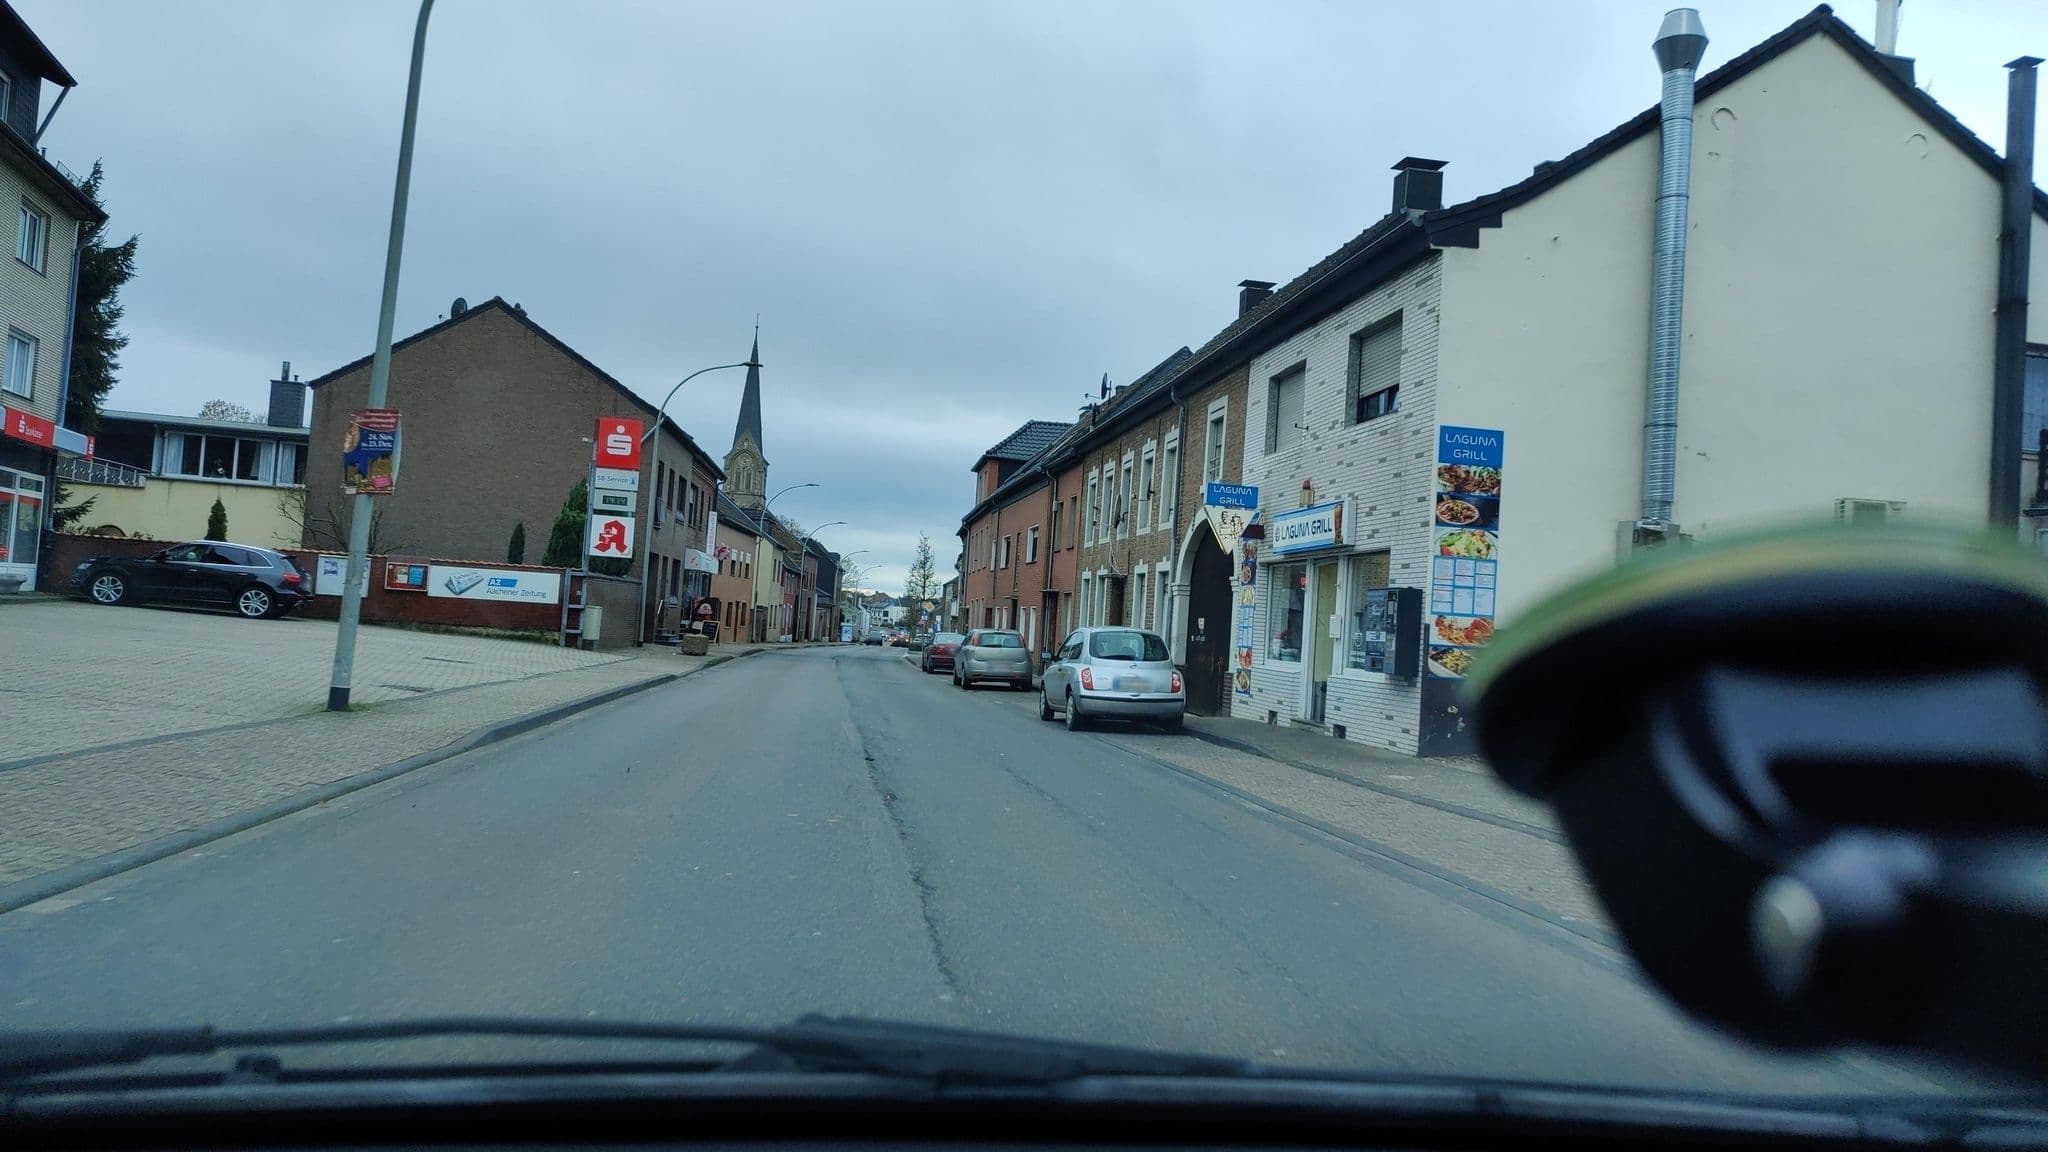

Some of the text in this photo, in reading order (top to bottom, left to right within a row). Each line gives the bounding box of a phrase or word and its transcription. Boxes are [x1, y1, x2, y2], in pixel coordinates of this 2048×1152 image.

[1445, 433, 1497, 447] LAGUNA
[1453, 449, 1488, 460] GRILL
[1213, 485, 1252, 496] LAGUNA
[1219, 496, 1245, 506] GRILL
[1281, 517, 1332, 540] LAGUNA GRILL
[489, 578, 501, 586] AZ
[486, 587, 547, 599] Aachener Zeitung
